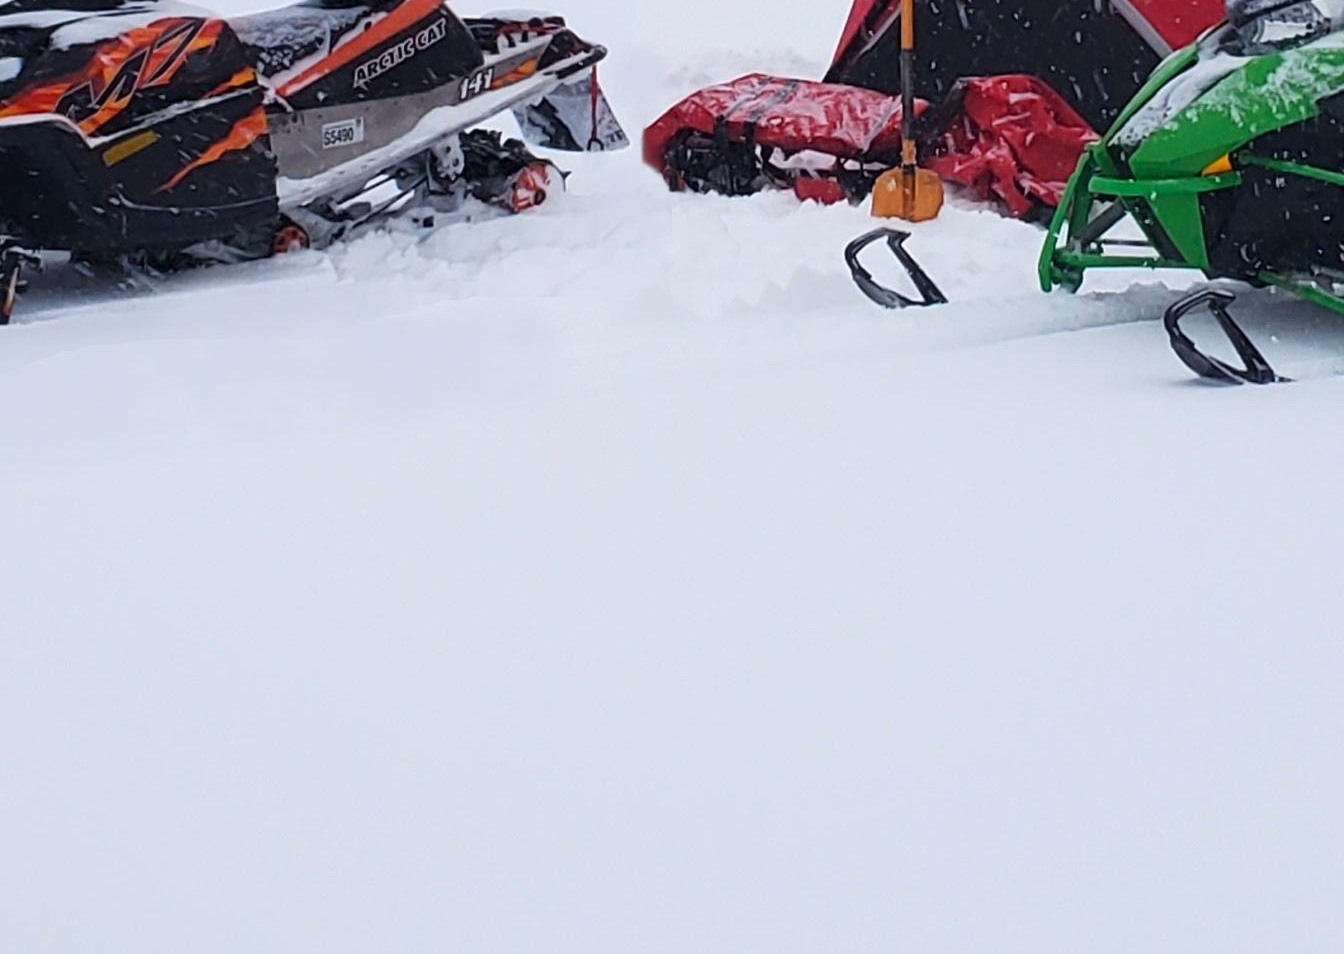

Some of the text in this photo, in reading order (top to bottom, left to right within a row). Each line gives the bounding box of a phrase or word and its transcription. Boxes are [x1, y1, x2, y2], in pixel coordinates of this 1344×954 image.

[352, 17, 448, 90] ARCTIC CAT
[459, 68, 494, 100] 141
